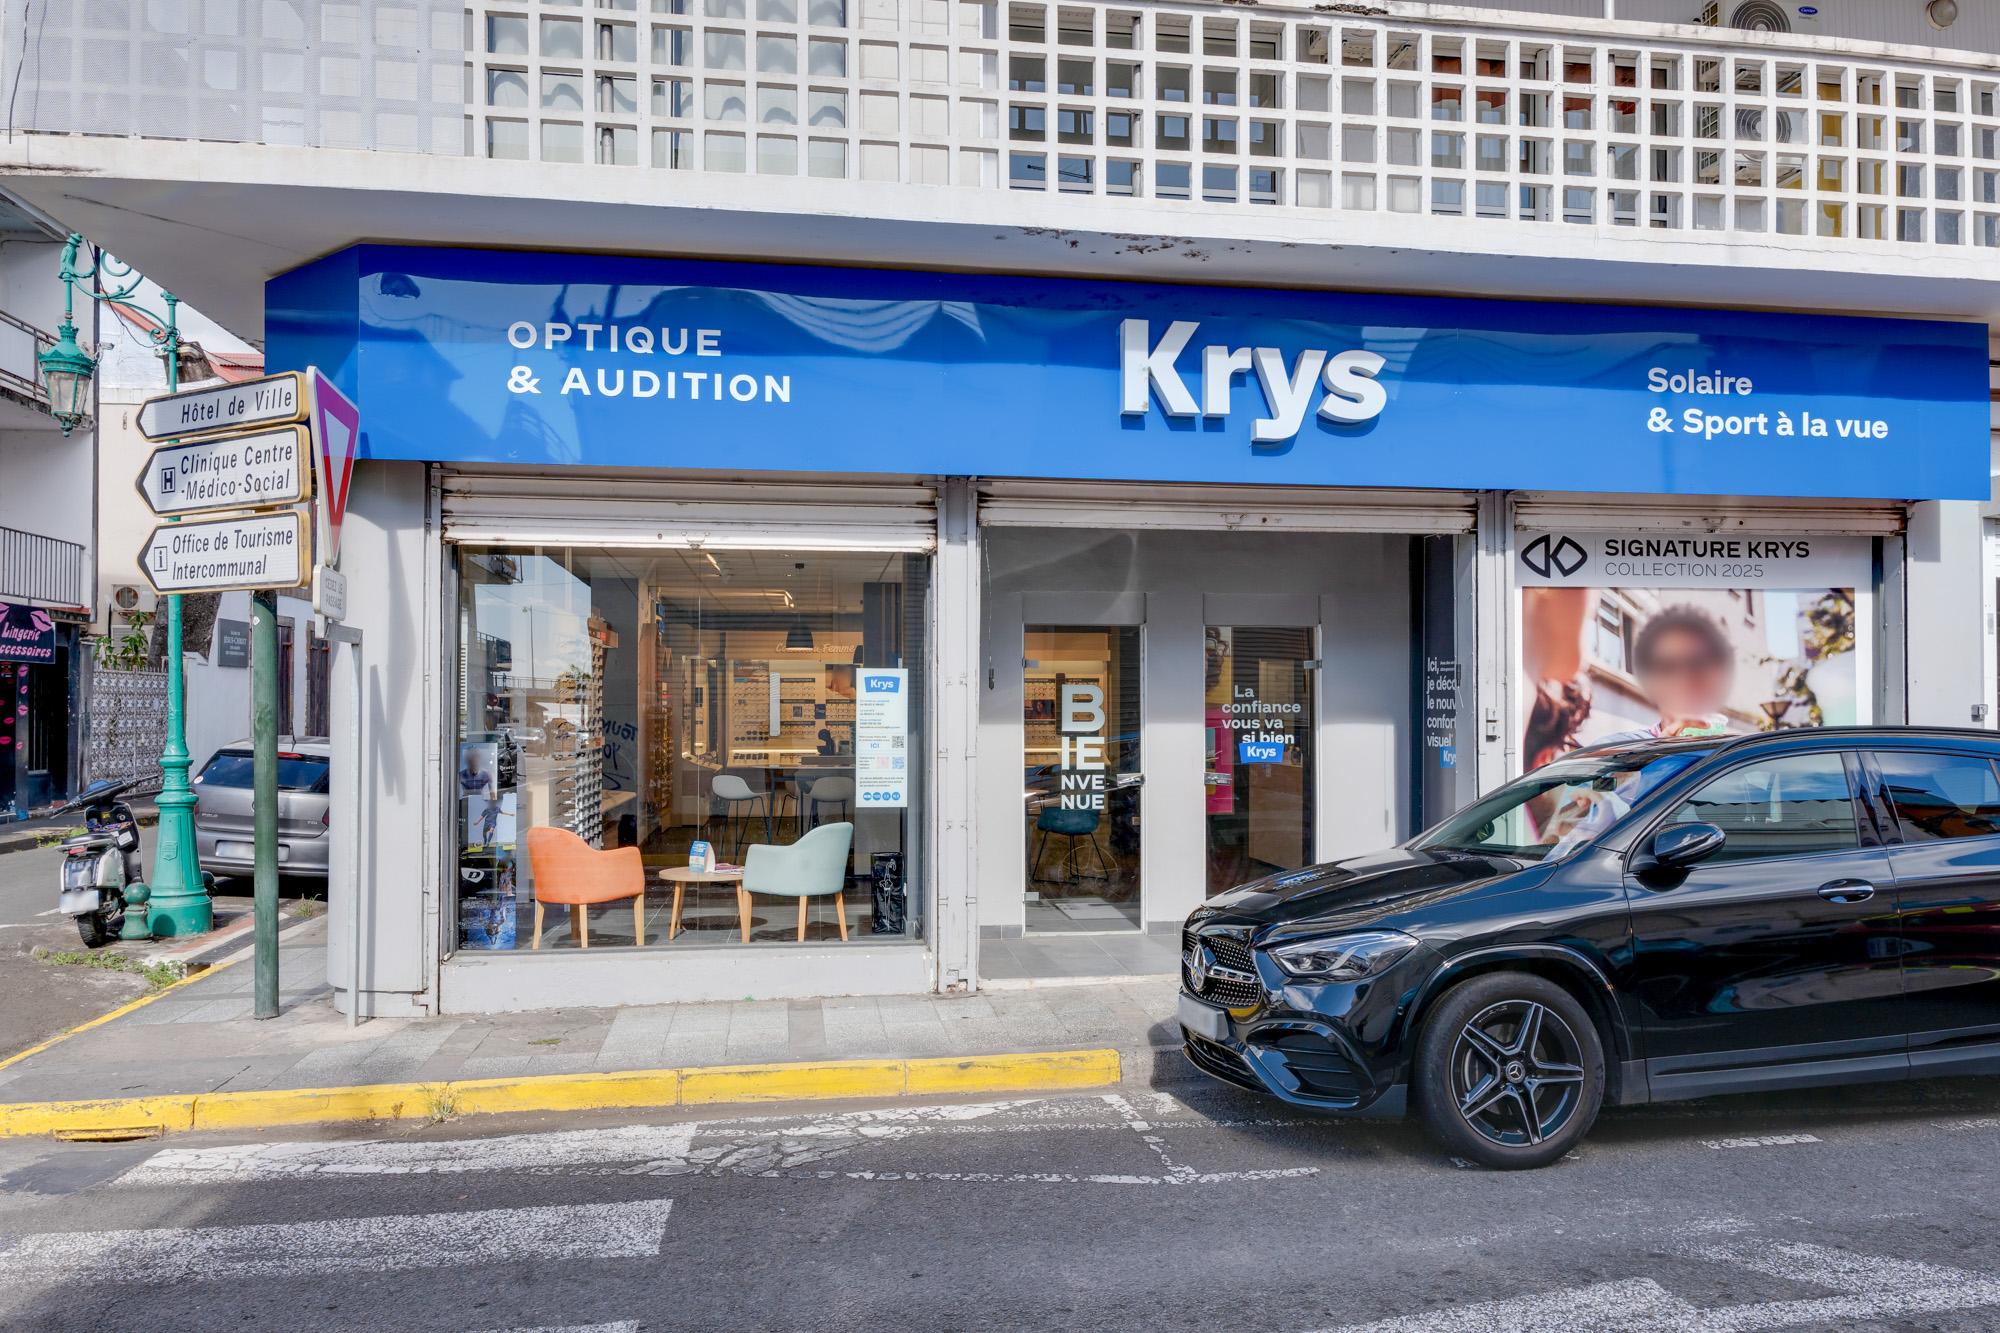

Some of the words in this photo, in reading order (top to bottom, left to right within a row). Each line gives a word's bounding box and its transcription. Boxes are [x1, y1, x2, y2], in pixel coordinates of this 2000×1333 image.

[507, 321, 722, 356] OPTIQUE
[507, 365, 542, 394] &
[560, 367, 790, 403] AUDITION
[1120, 318, 1387, 442] Krys
[1647, 366, 1753, 396] Solaire
[181, 397, 219, 424] Hôtel
[228, 395, 245, 416] de
[255, 388, 292, 412] Ville
[1647, 406, 1675, 433] &
[1683, 407, 1768, 440] Sport
[1776, 411, 1795, 436] à
[1802, 411, 1828, 437] la
[1836, 419, 1889, 439] vue
[181, 450, 238, 475] Clinique
[244, 445, 292, 466] Centre
[172, 533, 209, 554] Office
[213, 531, 229, 550] de
[234, 527, 293, 549] Tourisme
[1604, 539, 1741, 558] SIGNATURE
[1748, 541, 1810, 558] KRYS
[172, 554, 267, 580] Intercommunal
[1605, 562, 1718, 577] COLLECTION
[1722, 563, 1765, 578] 2025
[1, 622, 41, 641] Lingerie
[870, 679, 894, 690] Krys
[1234, 684, 1255, 698] La
[1426, 675, 1435, 694] je
[1221, 700, 1302, 714] confiance
[1427, 694, 1435, 709] le
[1221, 718, 1260, 729] vous
[1264, 718, 1284, 729] va
[1242, 731, 1256, 744] si
[1259, 731, 1295, 744] bien
[1247, 745, 1277, 760] Krys
[1061, 774, 1105, 790] NVE
[1061, 794, 1105, 810] NUE
